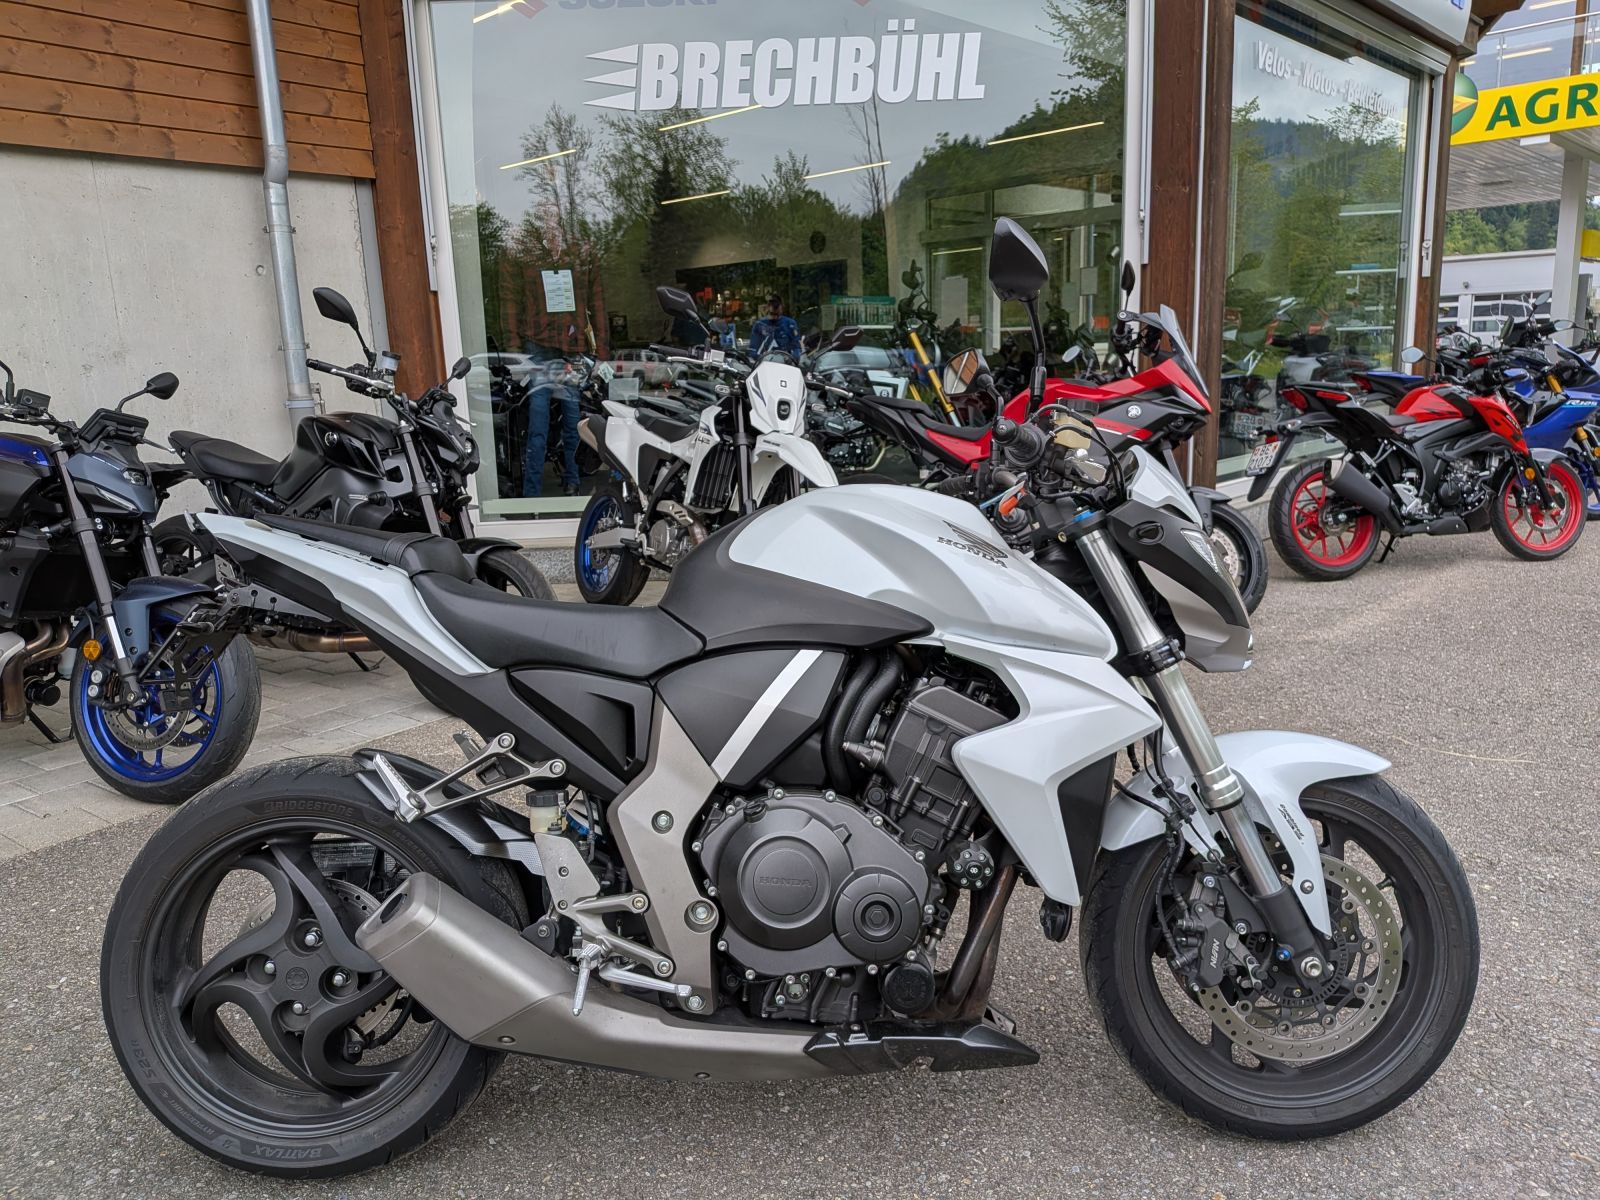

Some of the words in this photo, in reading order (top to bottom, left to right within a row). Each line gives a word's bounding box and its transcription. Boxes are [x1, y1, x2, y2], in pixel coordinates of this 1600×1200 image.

[638, 18, 986, 112] BRECHBÜHL
[1257, 39, 1292, 80] Velos
[937, 536, 1008, 569] HONDA
[263, 800, 355, 817] BRIDGESTONE
[759, 876, 813, 888] HONDA
[254, 1143, 323, 1161] BATTLAX
